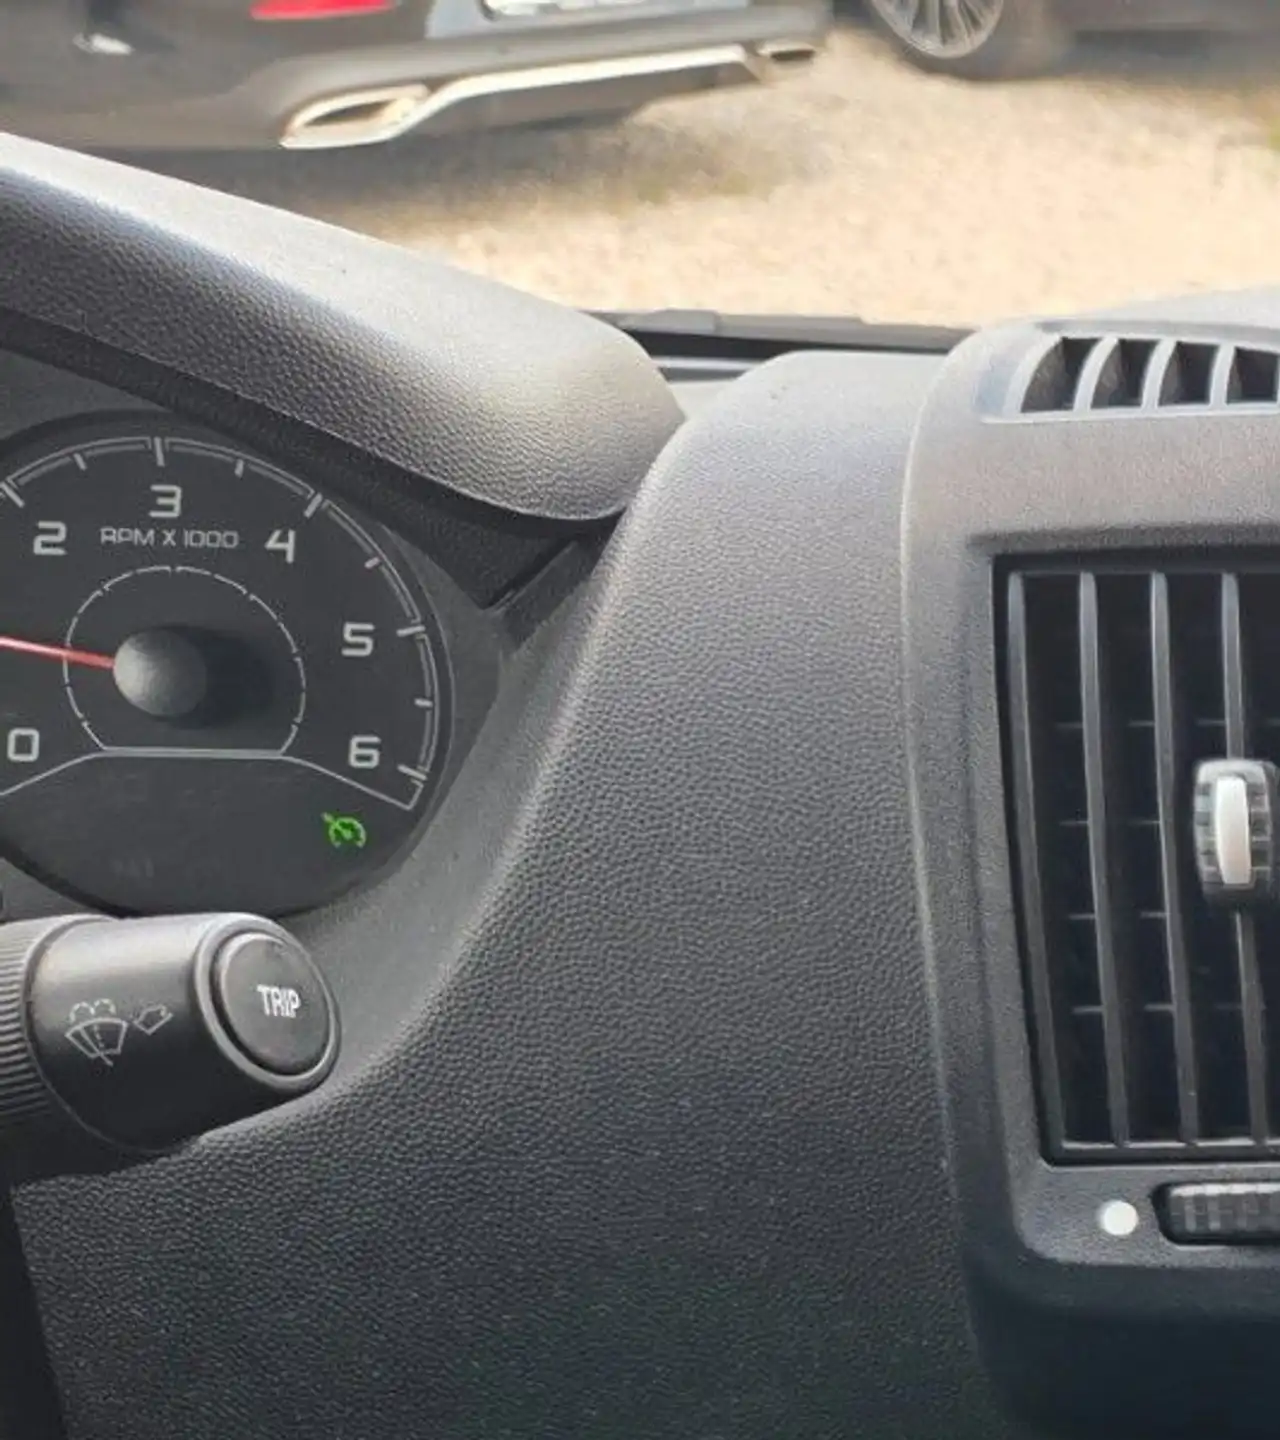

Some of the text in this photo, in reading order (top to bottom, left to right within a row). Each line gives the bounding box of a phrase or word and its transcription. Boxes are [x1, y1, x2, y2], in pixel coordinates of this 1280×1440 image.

[150, 485, 182, 518] 3
[33, 521, 68, 555] 2
[100, 527, 240, 548] RPM X 1000
[265, 529, 296, 563] 4
[341, 623, 374, 657] 5
[7, 727, 40, 762] 0
[348, 736, 381, 769] 6
[256, 983, 302, 1019] TRIP
